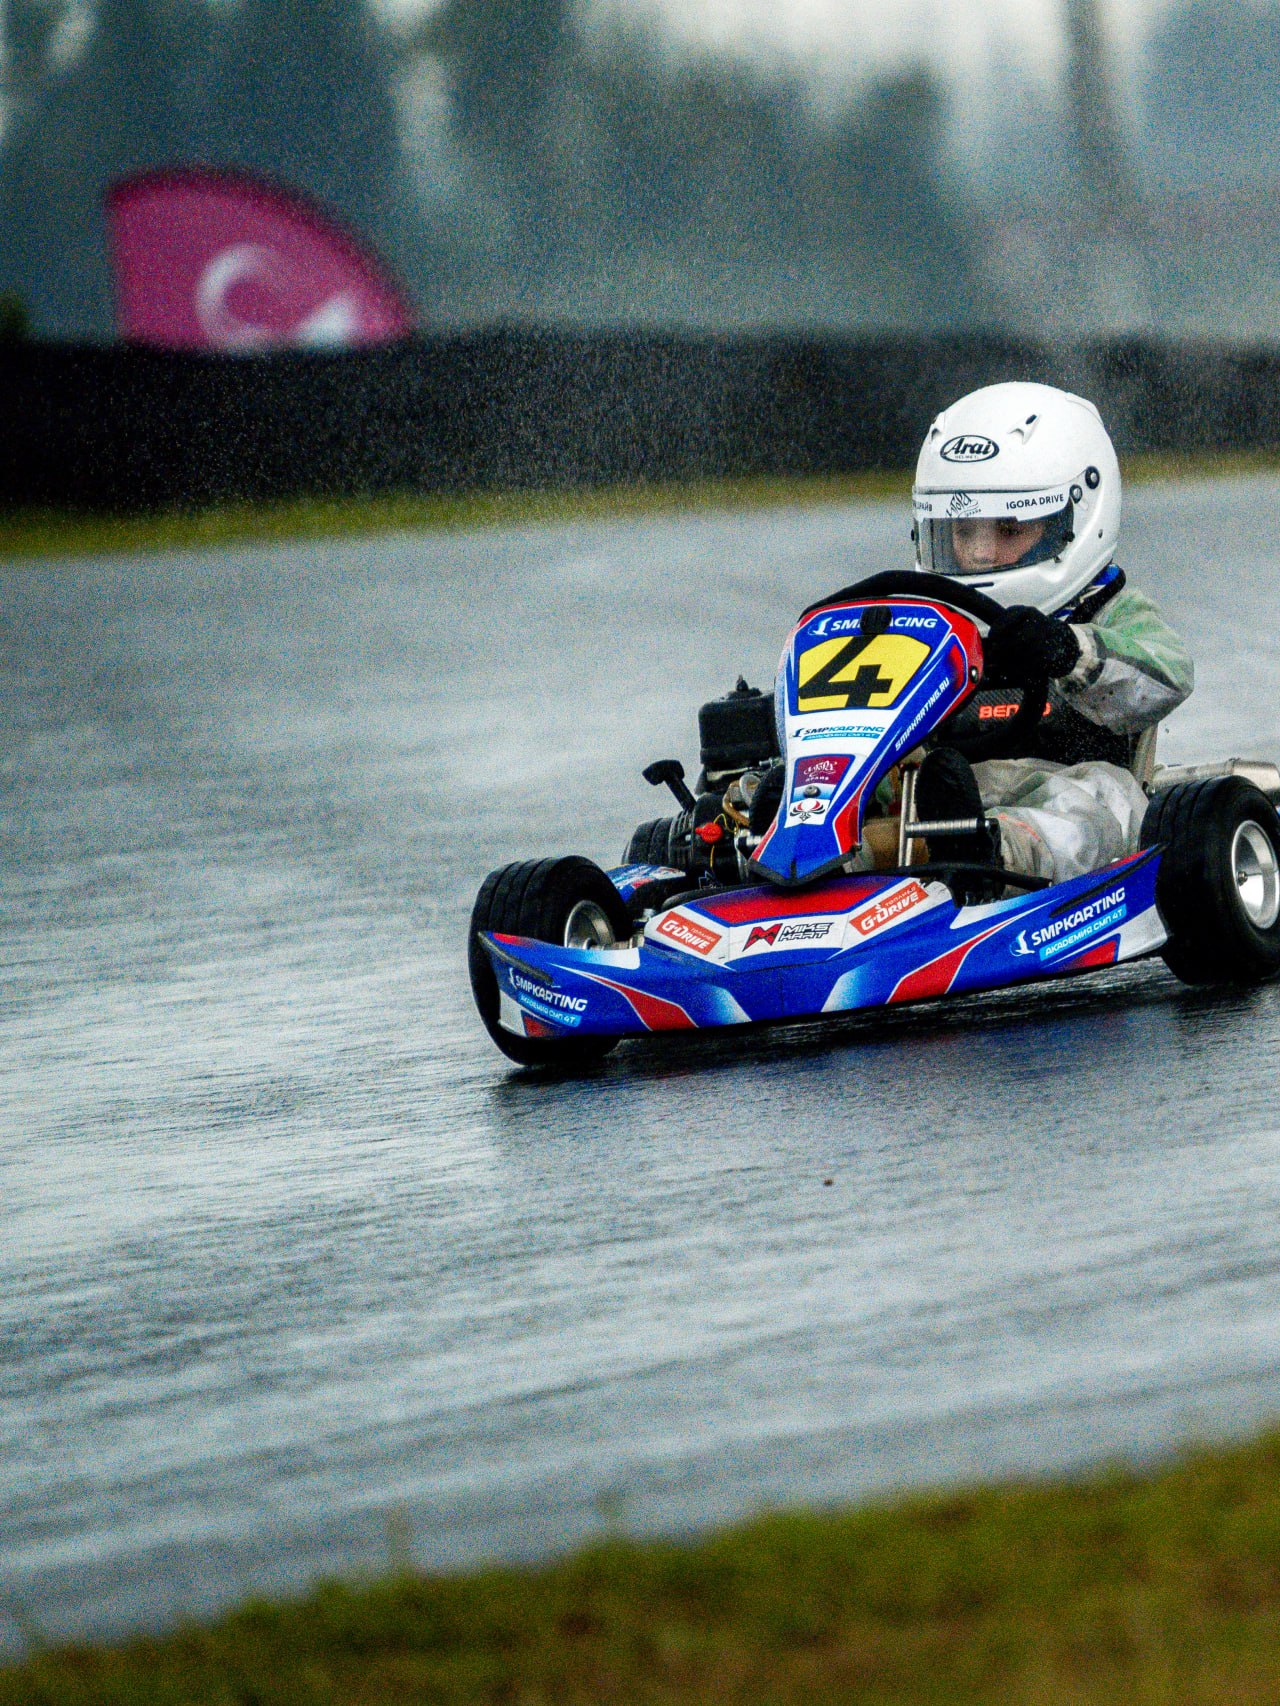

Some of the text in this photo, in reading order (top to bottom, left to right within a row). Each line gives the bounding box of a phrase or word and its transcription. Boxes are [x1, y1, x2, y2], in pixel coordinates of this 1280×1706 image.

[943, 437, 992, 455] Arai
[1006, 493, 1065, 510] IGORA DRIVE
[798, 633, 893, 708] 4
[804, 726, 886, 735] SMPKARTING
[1031, 887, 1126, 946] SMPKARTING
[515, 975, 588, 1012] SMPKARTING
